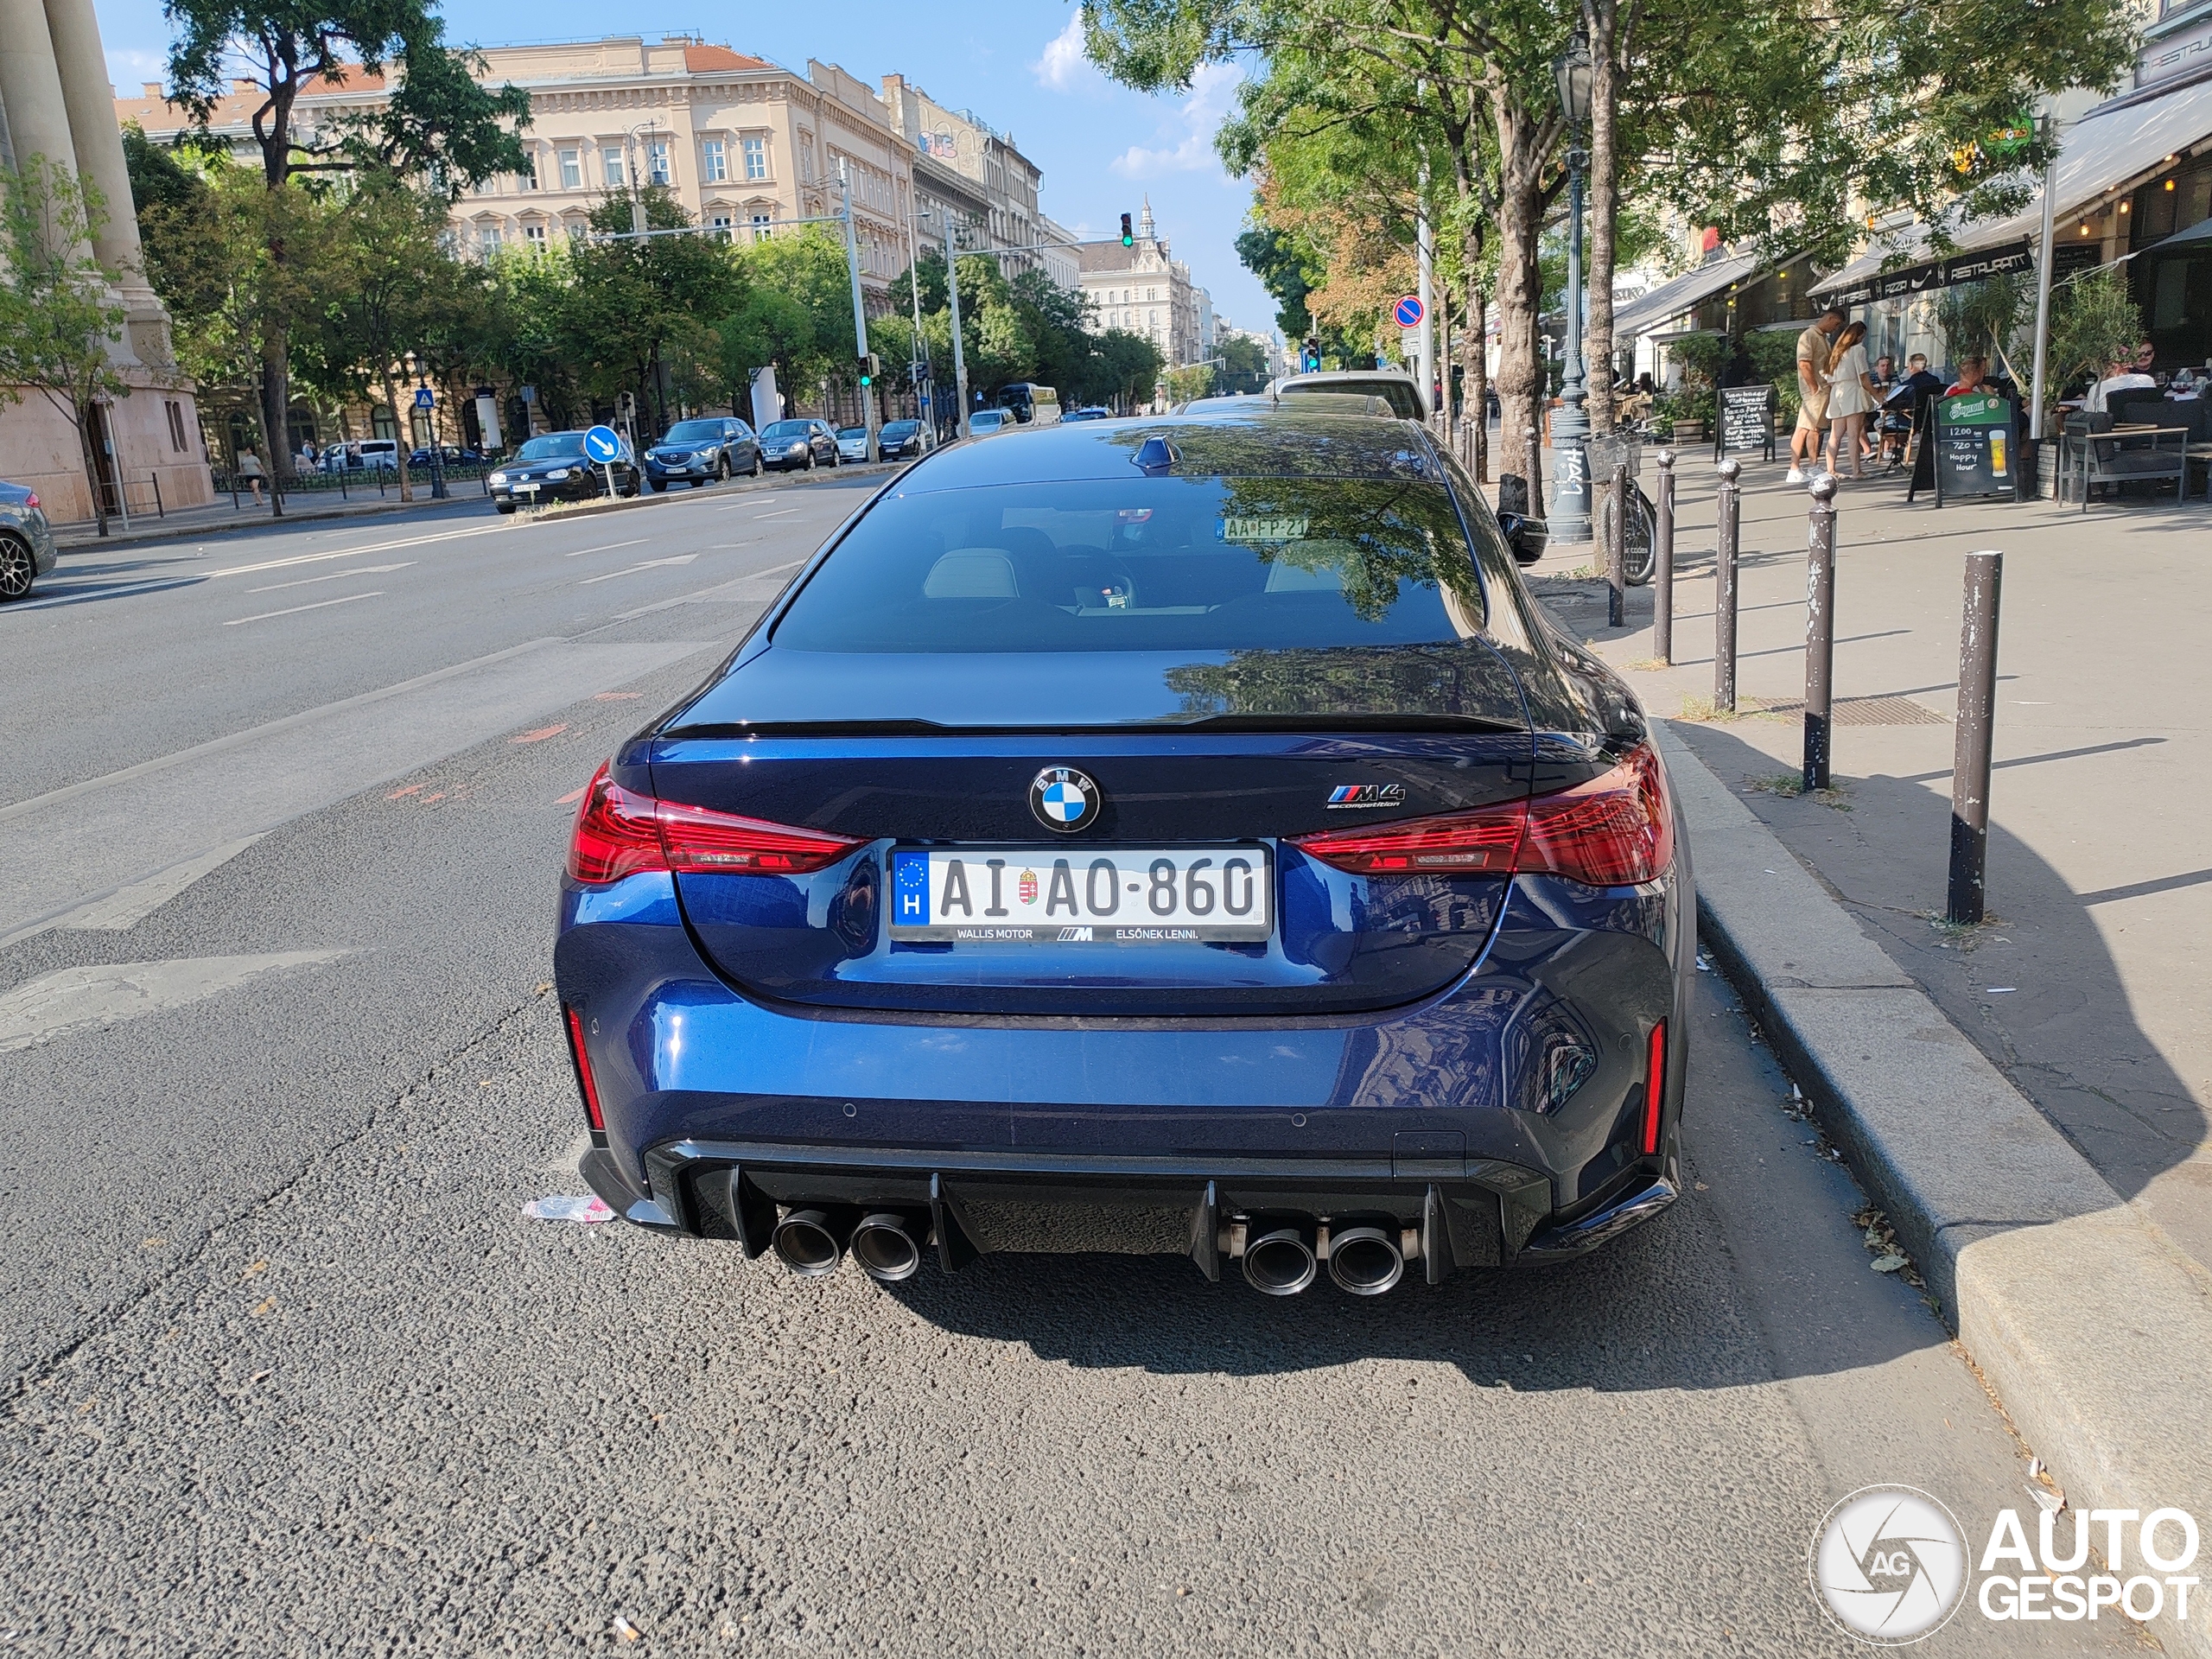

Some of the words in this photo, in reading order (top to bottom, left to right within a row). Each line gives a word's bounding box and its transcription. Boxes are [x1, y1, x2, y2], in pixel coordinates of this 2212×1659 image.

[2152, 36, 2212, 70] RESTAU
[1951, 253, 2026, 281] RESTAURANT
[1727, 395, 1767, 404] Flatbread
[1745, 405, 1758, 414] for
[1949, 400, 1985, 420] Soproni
[1952, 442, 1971, 450] 720
[1949, 453, 1978, 462] Happy
[1228, 519, 1249, 537] AA
[1036, 770, 1093, 792] BMW
[1338, 801, 1401, 810] competition
[940, 858, 1009, 917] AI
[1046, 857, 1253, 917] AO-860
[903, 893, 921, 915] H
[957, 929, 995, 939] WALLIS
[995, 929, 1033, 939] MOTOR
[1116, 927, 1164, 940] ELSŐNEK
[1165, 929, 1199, 940] LENNI.
